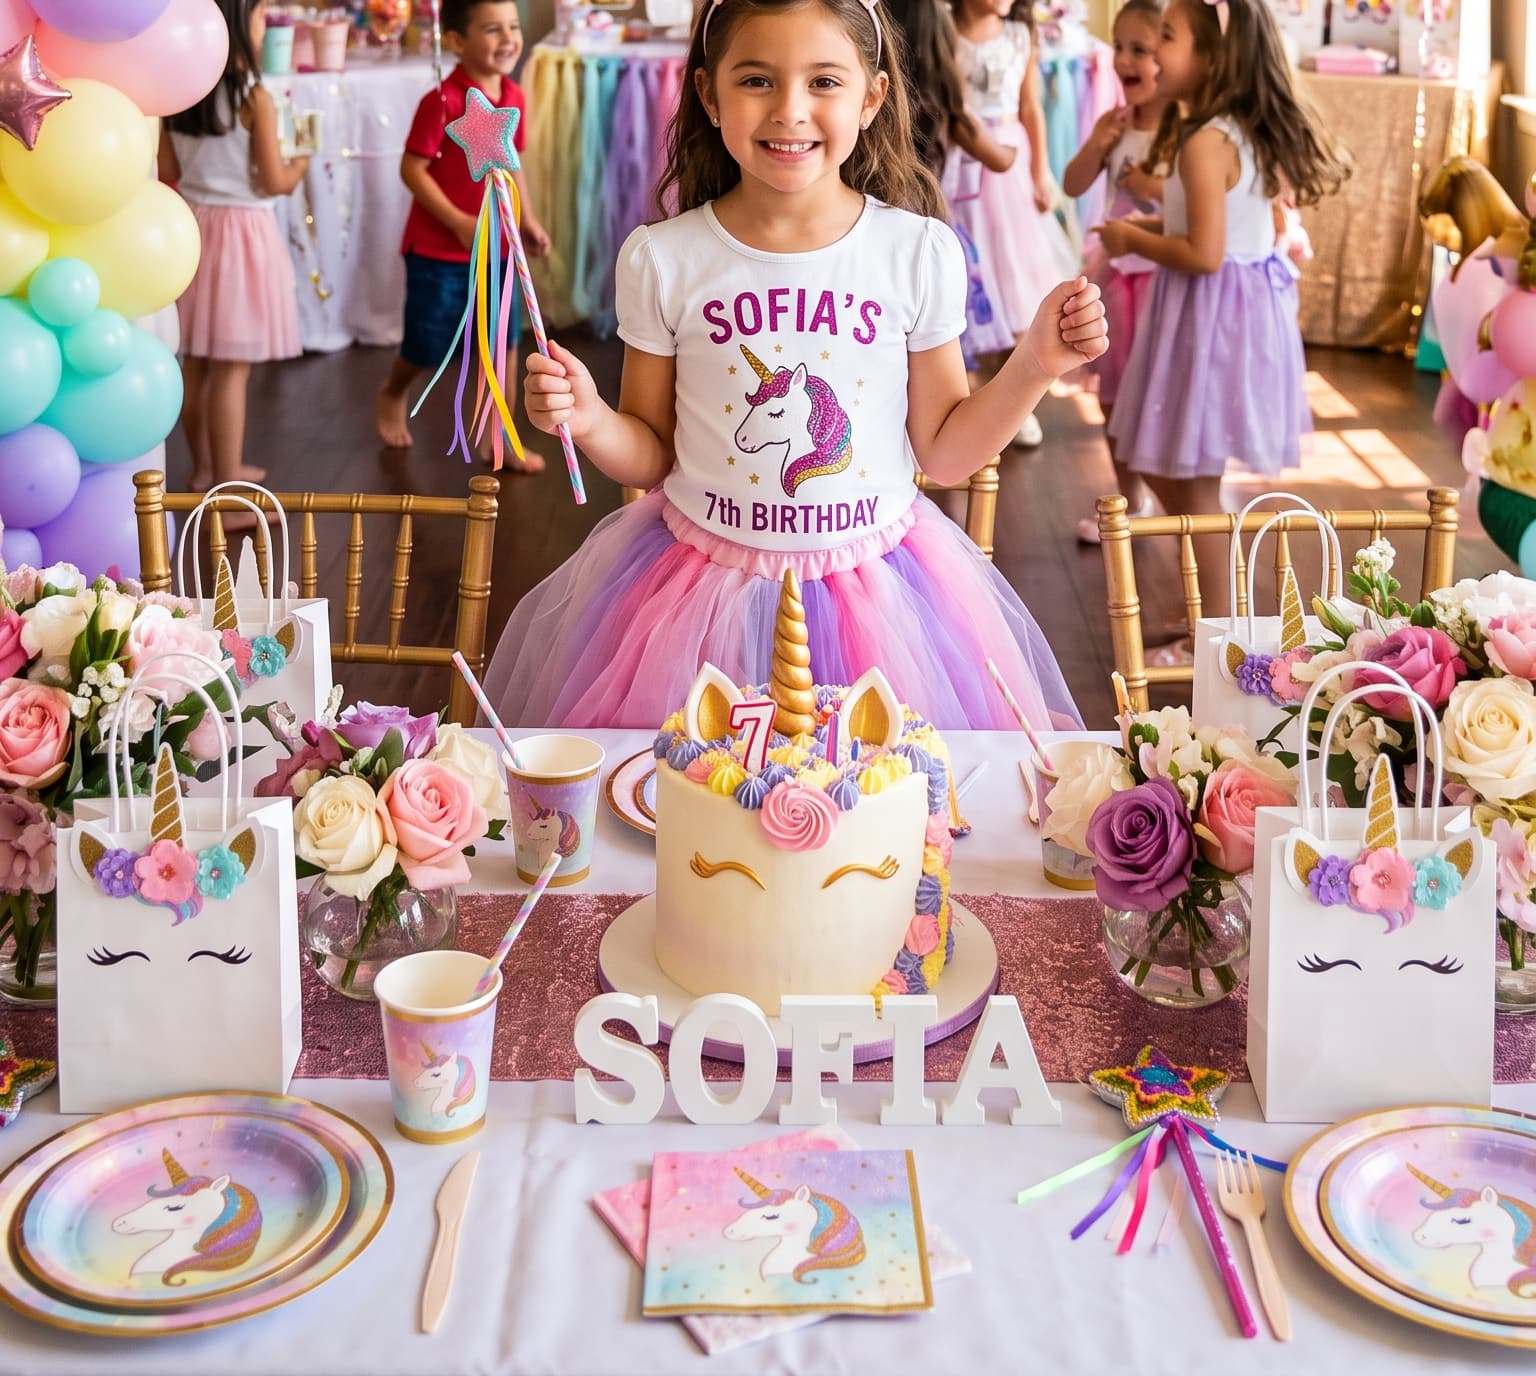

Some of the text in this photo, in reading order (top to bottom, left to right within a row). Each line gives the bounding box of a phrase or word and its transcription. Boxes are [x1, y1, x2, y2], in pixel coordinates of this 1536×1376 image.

[702, 287, 882, 345] SOFIA'S
[704, 491, 879, 534] 7th BIRTHDAY
[729, 699, 778, 772] 7
[573, 991, 1063, 1125] SOFIA
